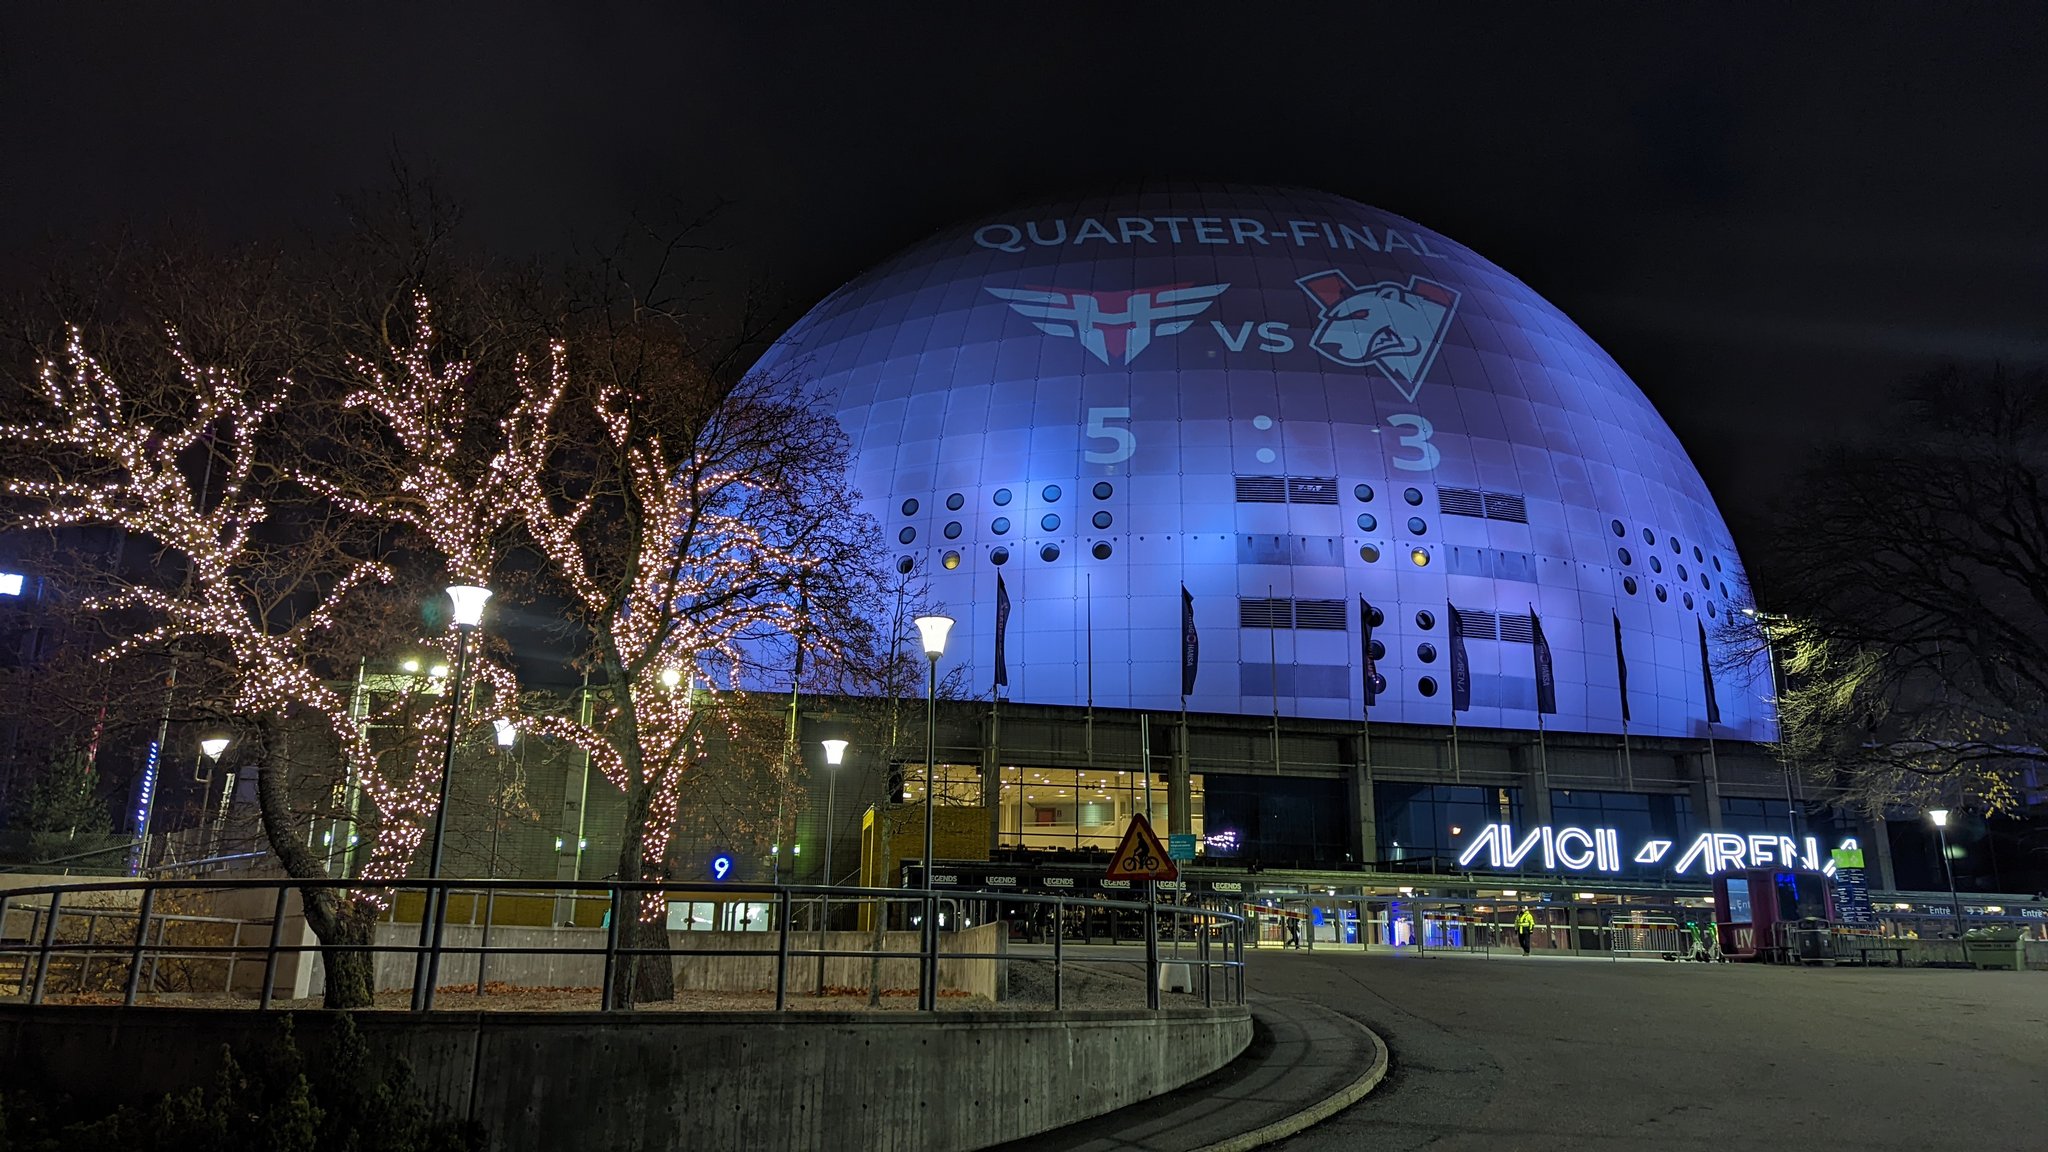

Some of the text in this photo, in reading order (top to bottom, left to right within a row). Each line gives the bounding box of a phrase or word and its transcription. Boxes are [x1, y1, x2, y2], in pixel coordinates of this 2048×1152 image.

[973, 217, 1448, 258] QUARTER-FINAL
[1210, 320, 1295, 353] VS
[1084, 407, 1137, 464] 5
[1386, 413, 1441, 471] 3
[1457, 656, 1465, 692] ARENA
[1459, 824, 1620, 872] AVICII
[714, 857, 730, 879] 9
[931, 875, 957, 884] EGENDS
[985, 876, 1017, 886] LEGENDS
[1043, 877, 1075, 887] LEGENDS
[1100, 879, 1131, 889] LEGENDS
[1156, 880, 1187, 890] LEGENS
[1212, 882, 1242, 892] LEGENDS
[1929, 905, 1951, 915] Entré
